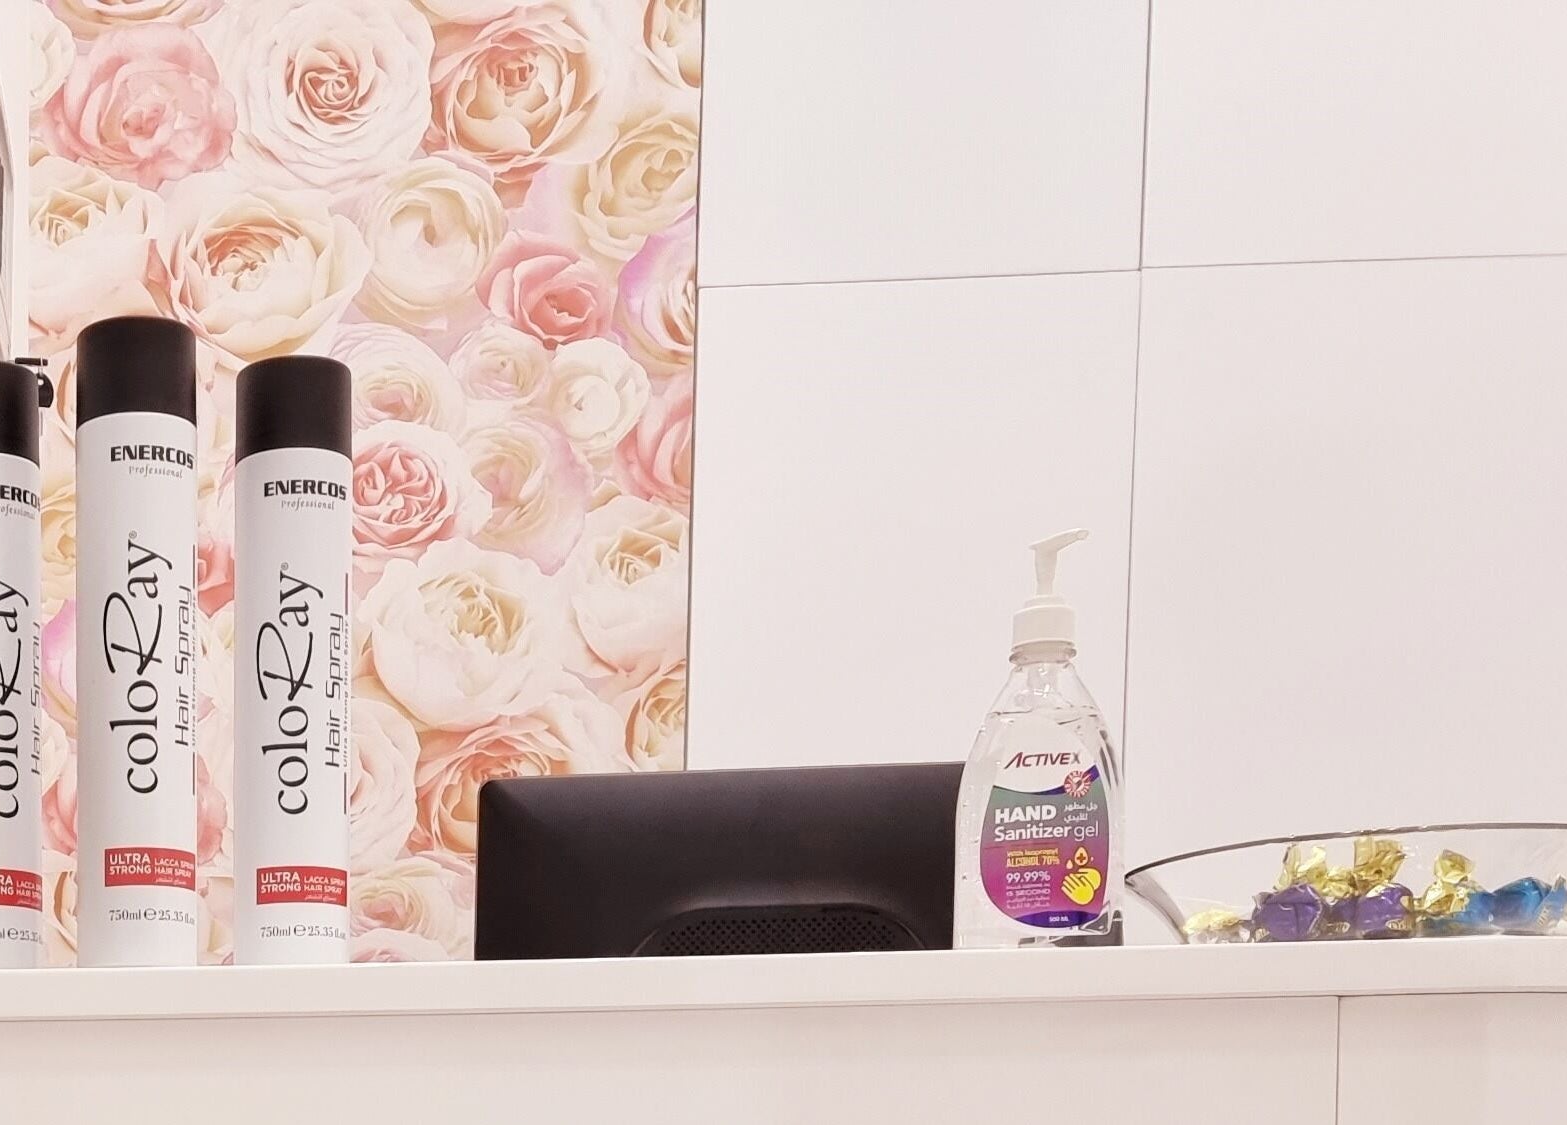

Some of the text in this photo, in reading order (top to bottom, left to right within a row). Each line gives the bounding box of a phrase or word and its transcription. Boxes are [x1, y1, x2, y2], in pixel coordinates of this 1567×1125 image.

[110, 444, 195, 470] ENERCOS
[128, 463, 183, 479] professional
[263, 479, 348, 501] ENERCOS
[280, 496, 335, 511] professional
[174, 585, 192, 747] Hair Spray
[324, 612, 344, 768] Hair Spray
[994, 804, 1057, 825] HAND
[994, 820, 1099, 842] Sanitizer gel
[109, 853, 151, 864] ULTRA
[154, 857, 180, 867] LACCA
[108, 864, 152, 875] STRONG
[154, 866, 173, 875] HAIR
[260, 871, 301, 883] ULTRA
[303, 875, 329, 884] LACCA
[1006, 871, 1051, 883] 99.99%
[260, 882, 302, 893] STRONG
[303, 884, 323, 892] HAIR
[109, 908, 184, 922] 750ml 25.35
[260, 925, 333, 939] 750ml 25.35
